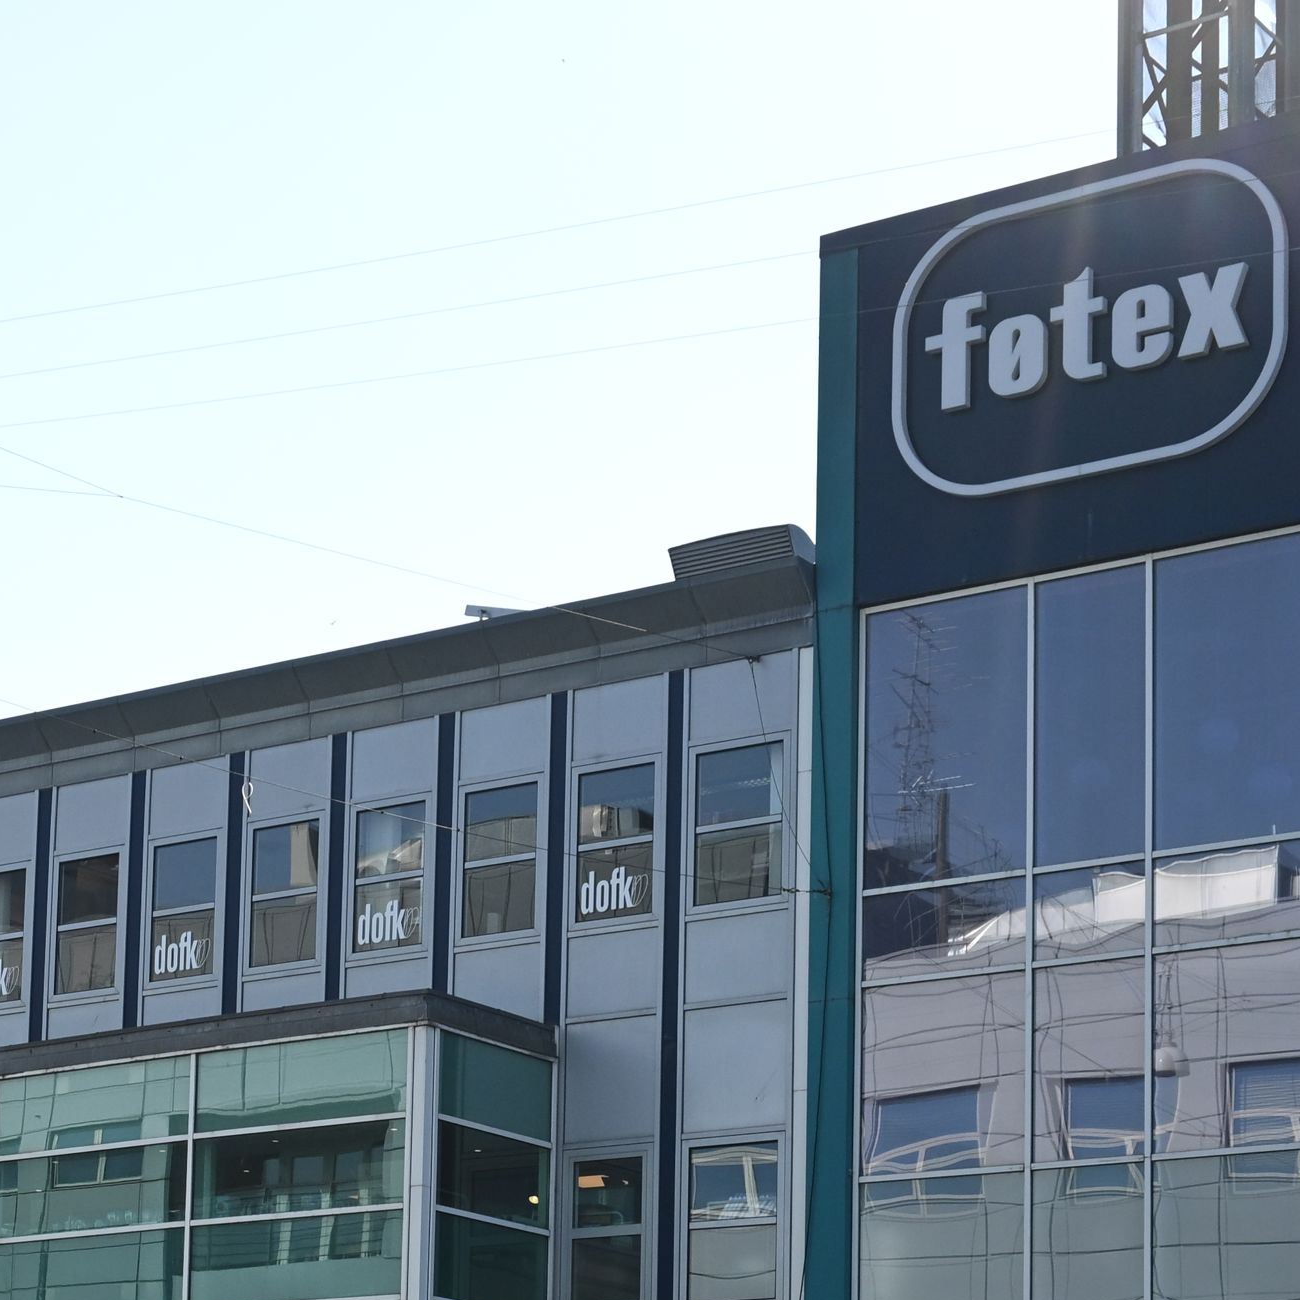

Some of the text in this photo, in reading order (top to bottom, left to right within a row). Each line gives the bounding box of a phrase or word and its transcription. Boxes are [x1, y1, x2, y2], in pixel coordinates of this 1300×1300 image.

[925, 262, 1249, 413] føtex
[581, 865, 635, 914] dofk
[358, 900, 407, 945] dofk
[154, 930, 201, 976] dofk
